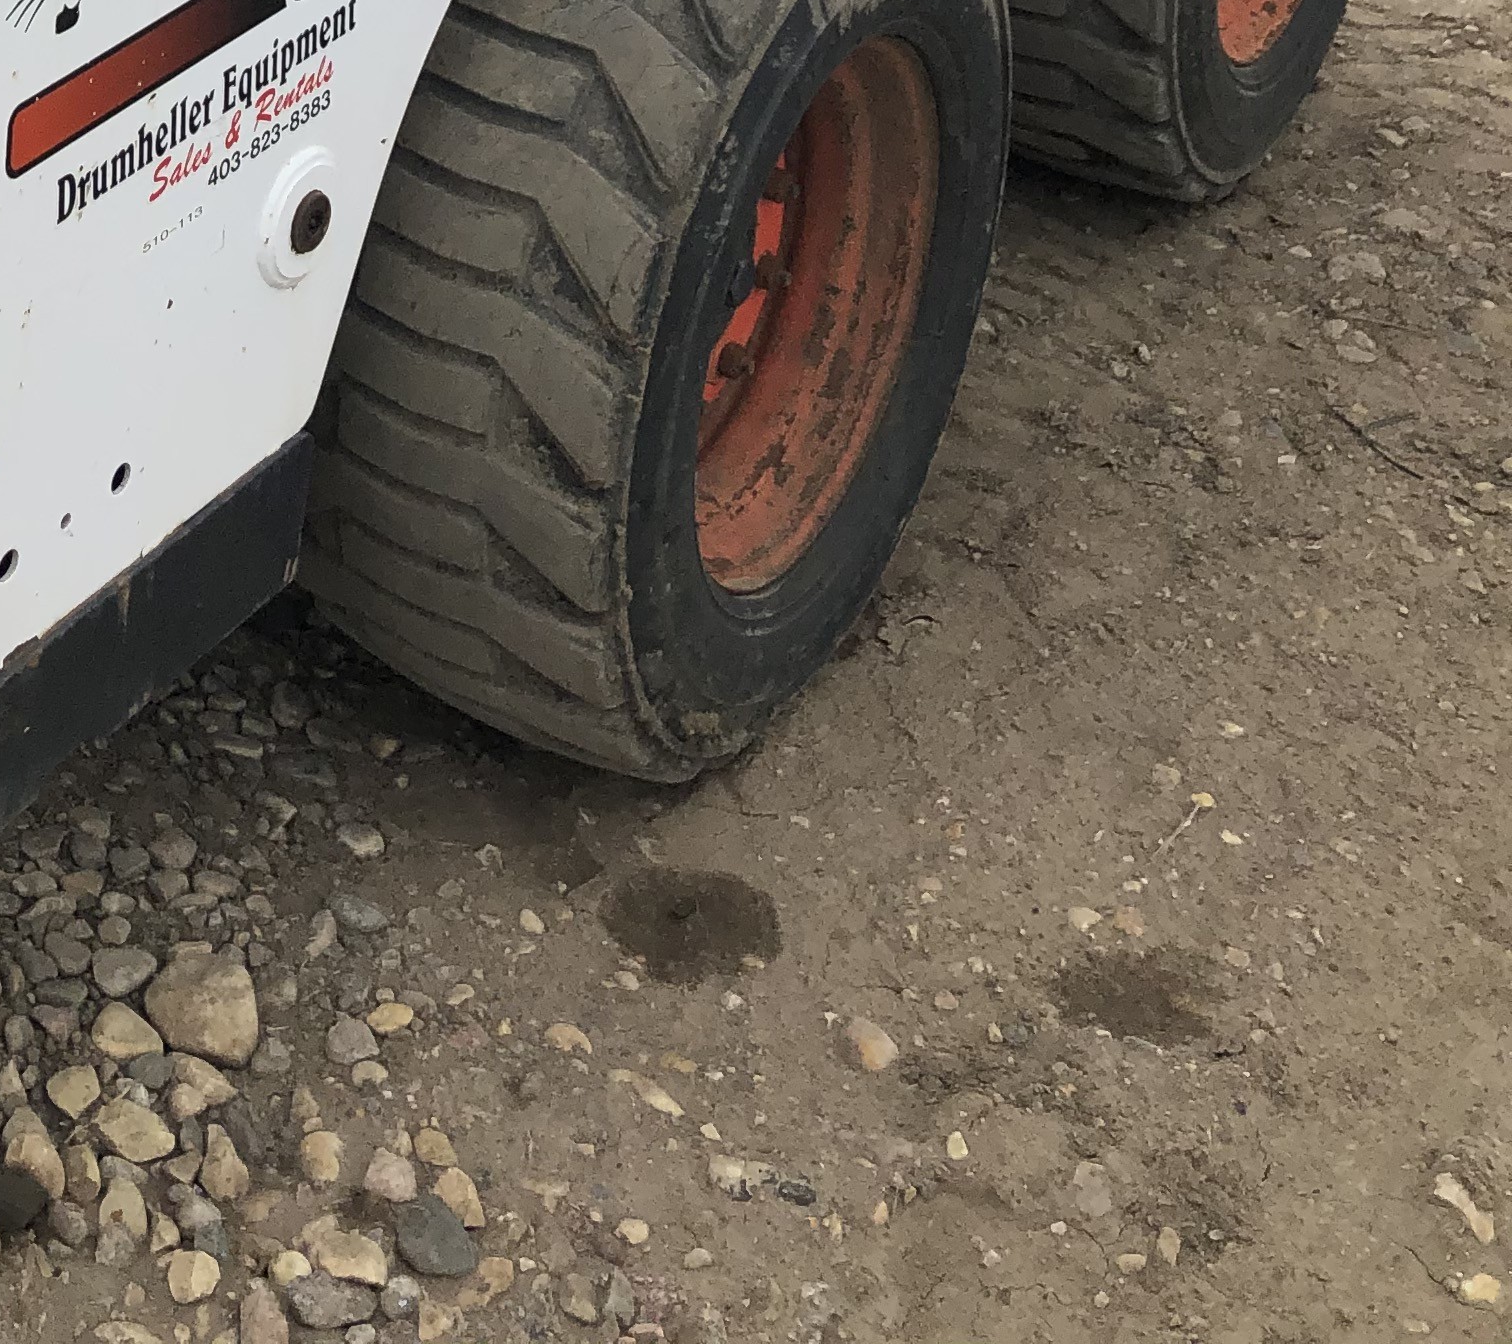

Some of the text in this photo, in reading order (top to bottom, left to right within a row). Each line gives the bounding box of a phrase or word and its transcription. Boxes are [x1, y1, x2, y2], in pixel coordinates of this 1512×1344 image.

[57, 89, 215, 224] Drumheller
[149, 55, 335, 202] Sales & Rentals
[207, 89, 331, 186] 403-823-8383
